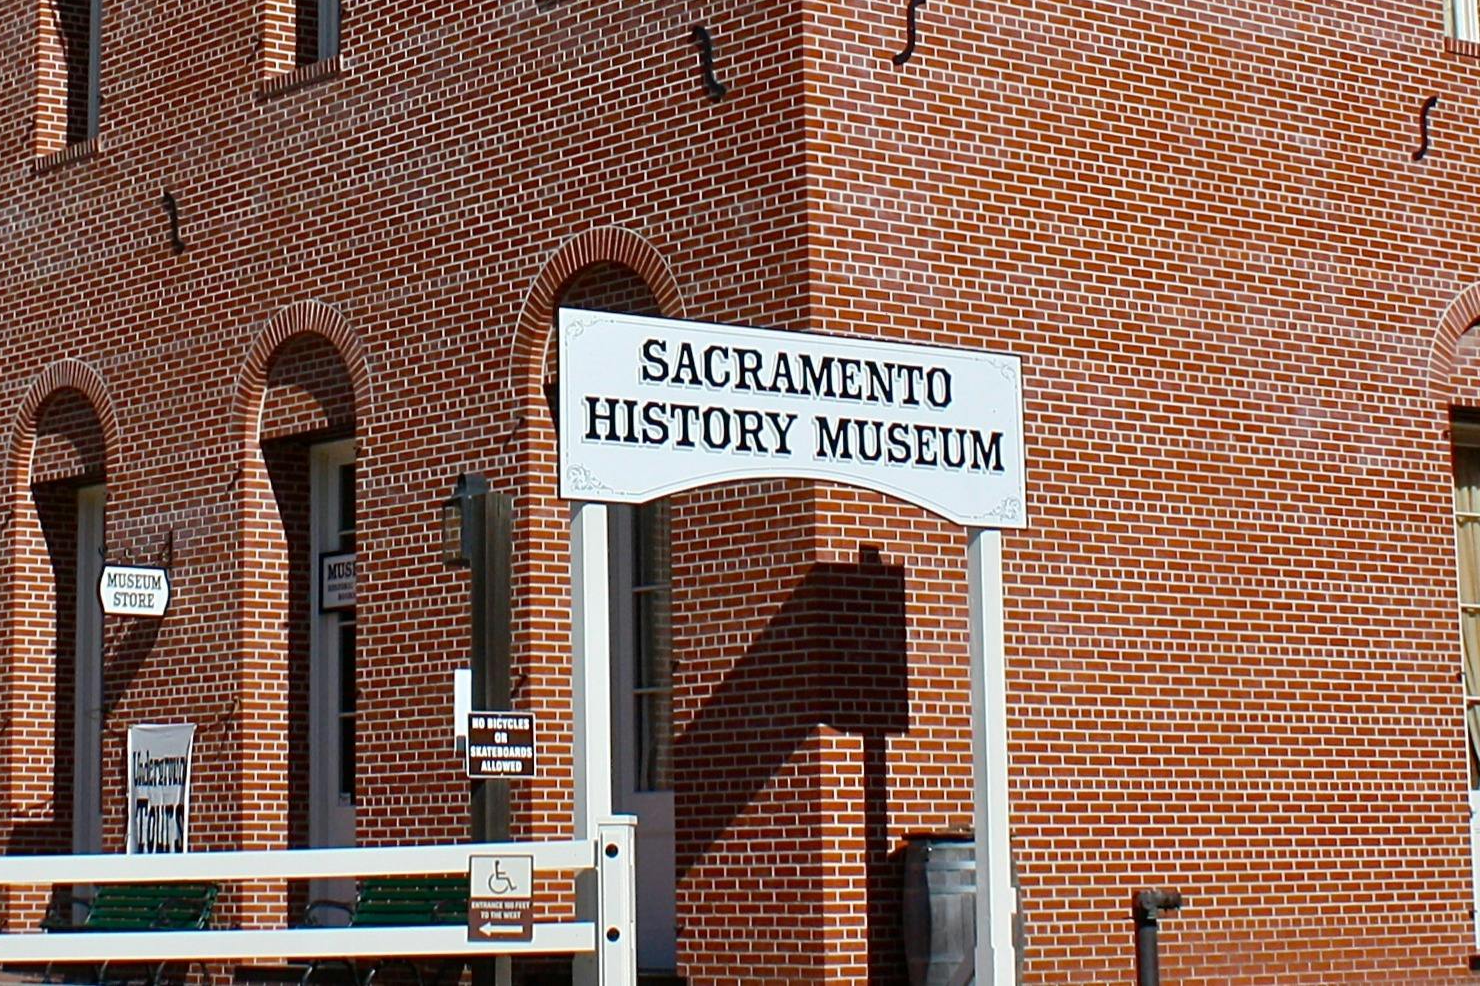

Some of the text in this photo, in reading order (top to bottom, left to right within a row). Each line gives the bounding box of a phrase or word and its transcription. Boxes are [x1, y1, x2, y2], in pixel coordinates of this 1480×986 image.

[641, 338, 953, 409] SACRAMENTO
[583, 396, 1006, 473] HISTORY MUSEUM
[107, 572, 162, 590] MUSEUM
[113, 591, 155, 609] STORE
[471, 717, 530, 730] NO BICYCLES
[494, 731, 508, 744] OR
[470, 745, 533, 758] SKATEBOARDS
[133, 749, 188, 786] Undergroun
[481, 760, 523, 773] ALLOWED
